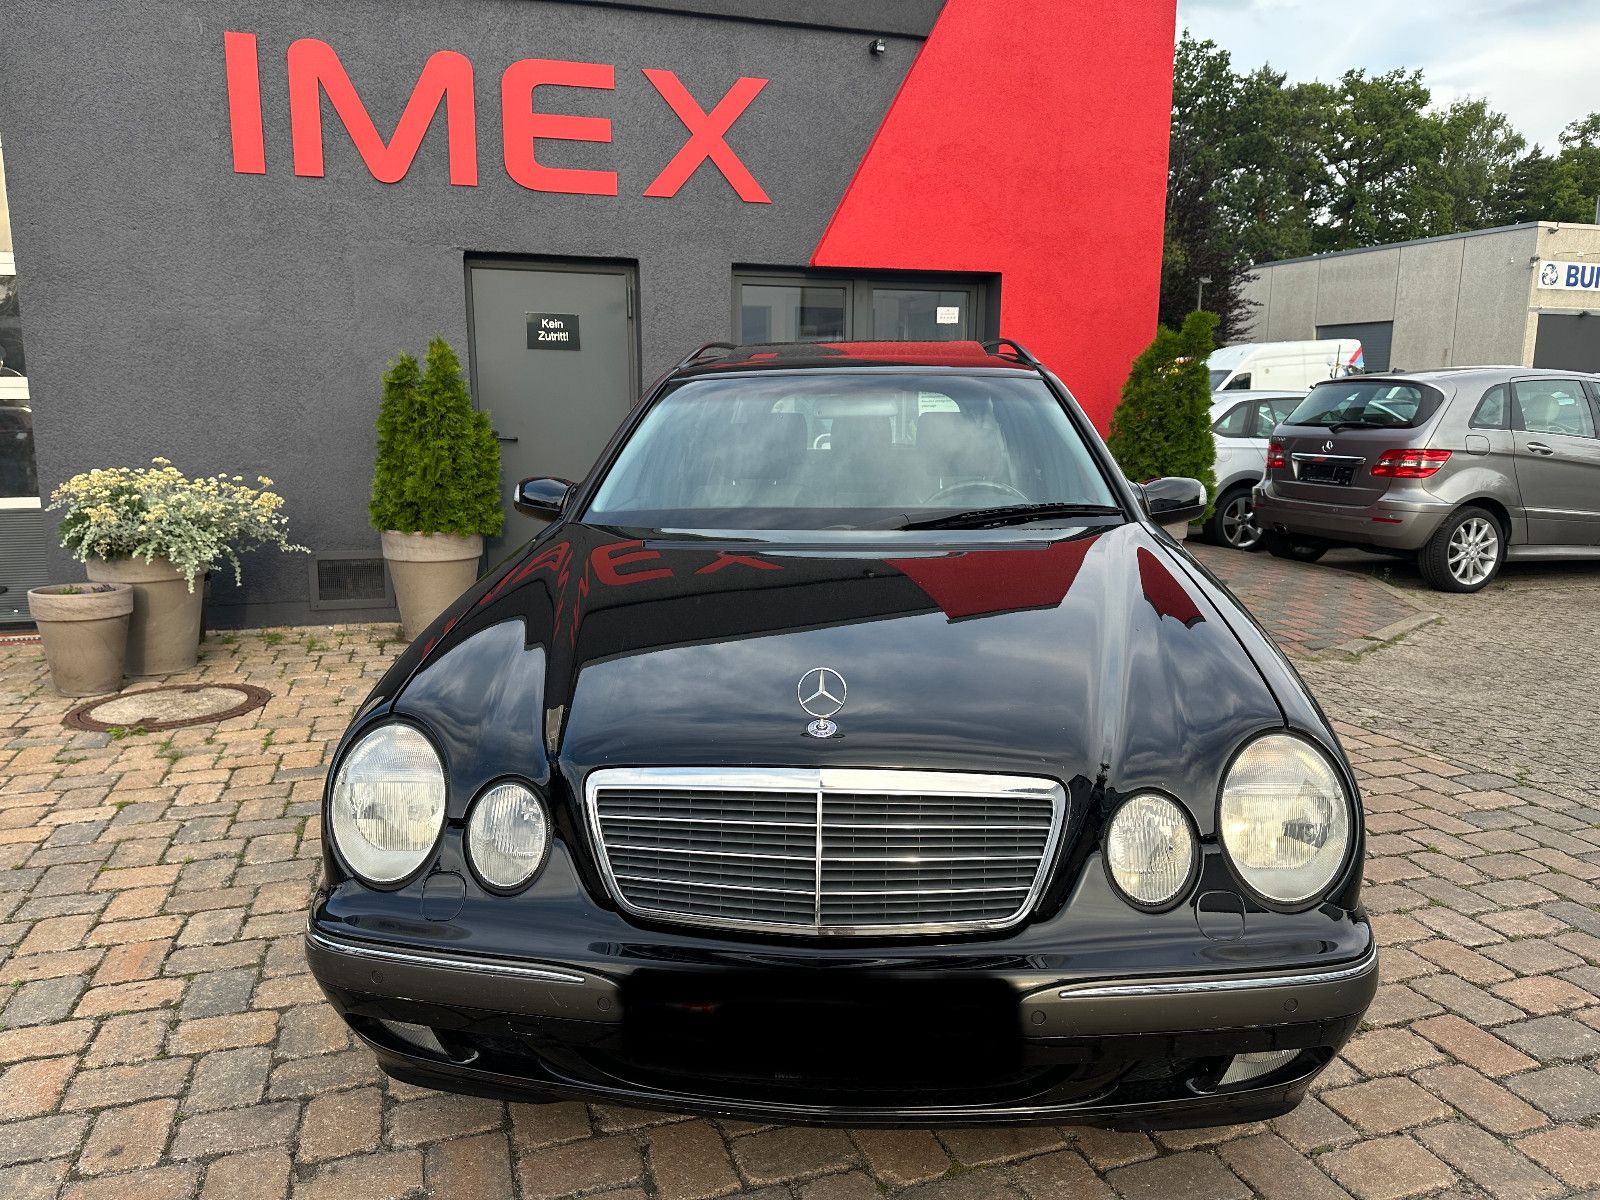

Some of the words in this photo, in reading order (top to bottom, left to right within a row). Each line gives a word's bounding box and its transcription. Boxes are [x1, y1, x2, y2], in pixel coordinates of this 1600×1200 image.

[224, 31, 772, 204] IMEX
[541, 319, 564, 329] Kein
[537, 331, 569, 342] Zutritt!
